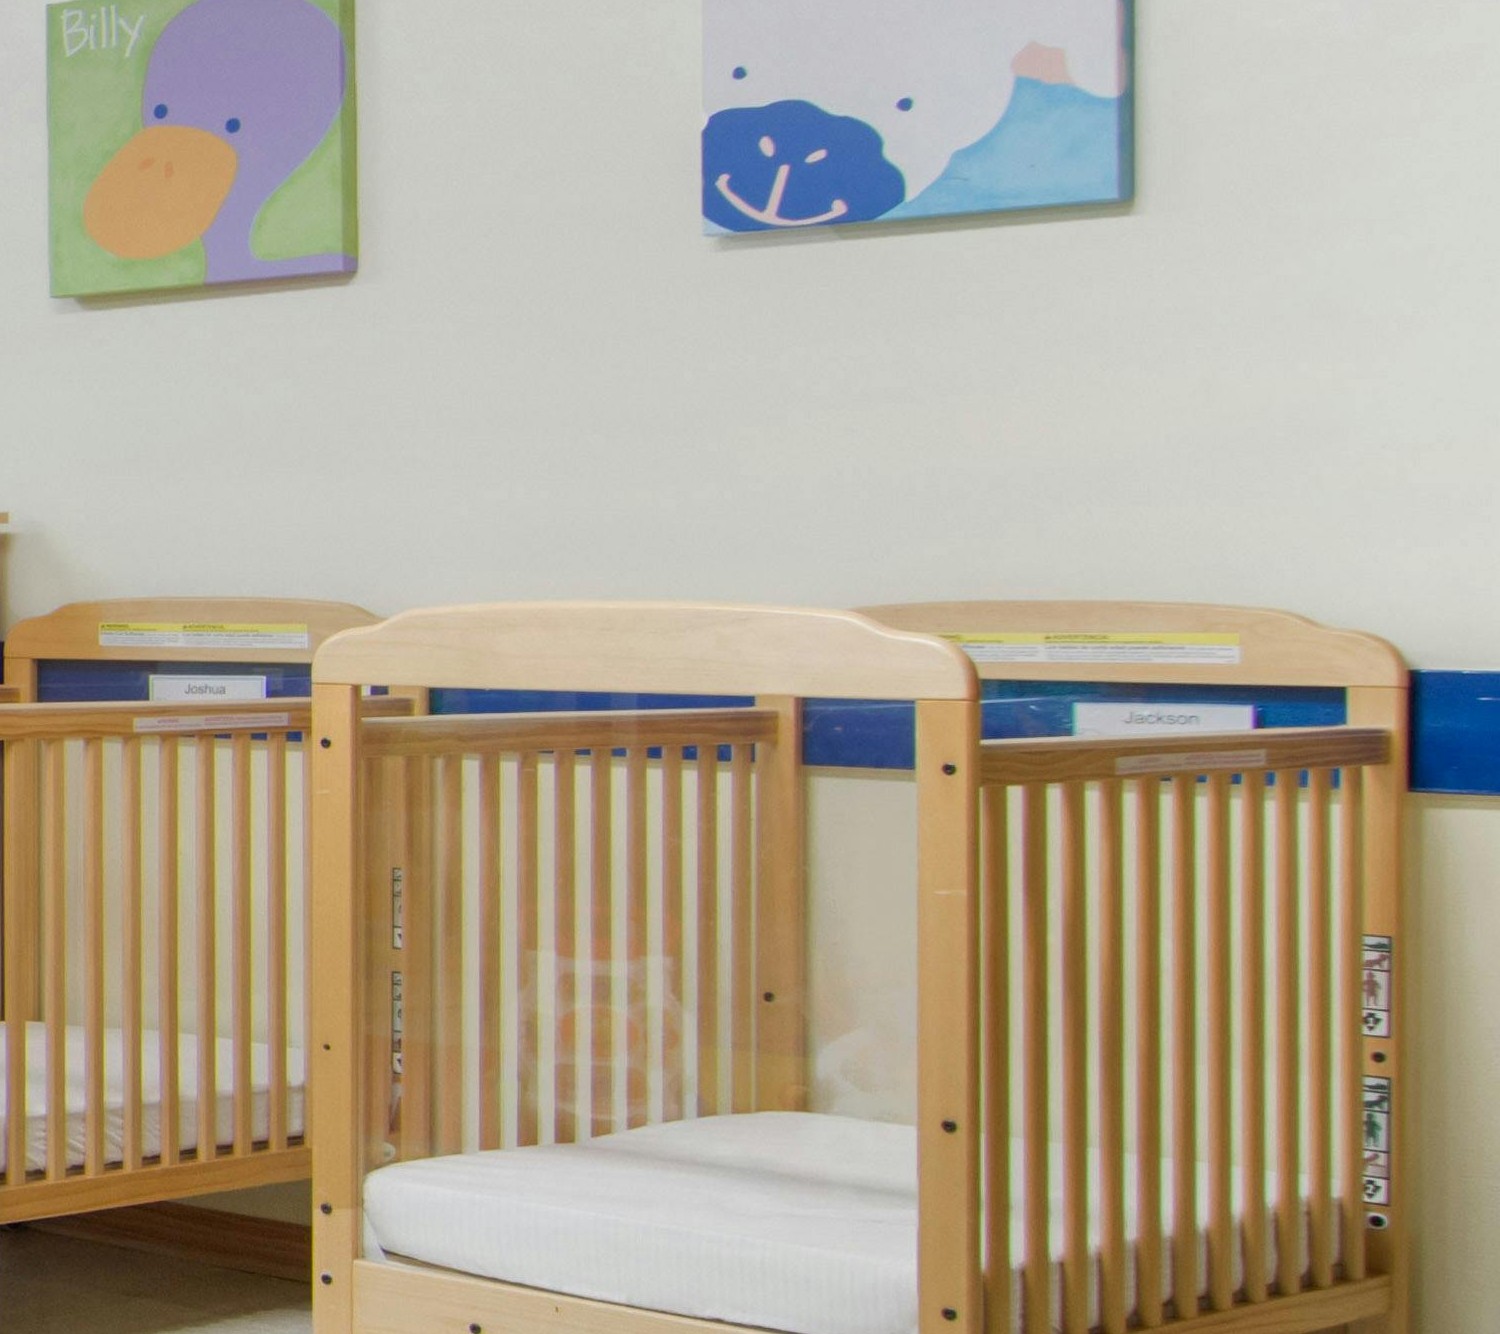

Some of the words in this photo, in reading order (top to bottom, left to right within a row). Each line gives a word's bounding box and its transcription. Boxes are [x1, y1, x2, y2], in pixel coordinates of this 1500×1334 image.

[61, 5, 146, 57] Billy
[184, 682, 227, 696] Joshua
[1123, 709, 1202, 727] Jackson
